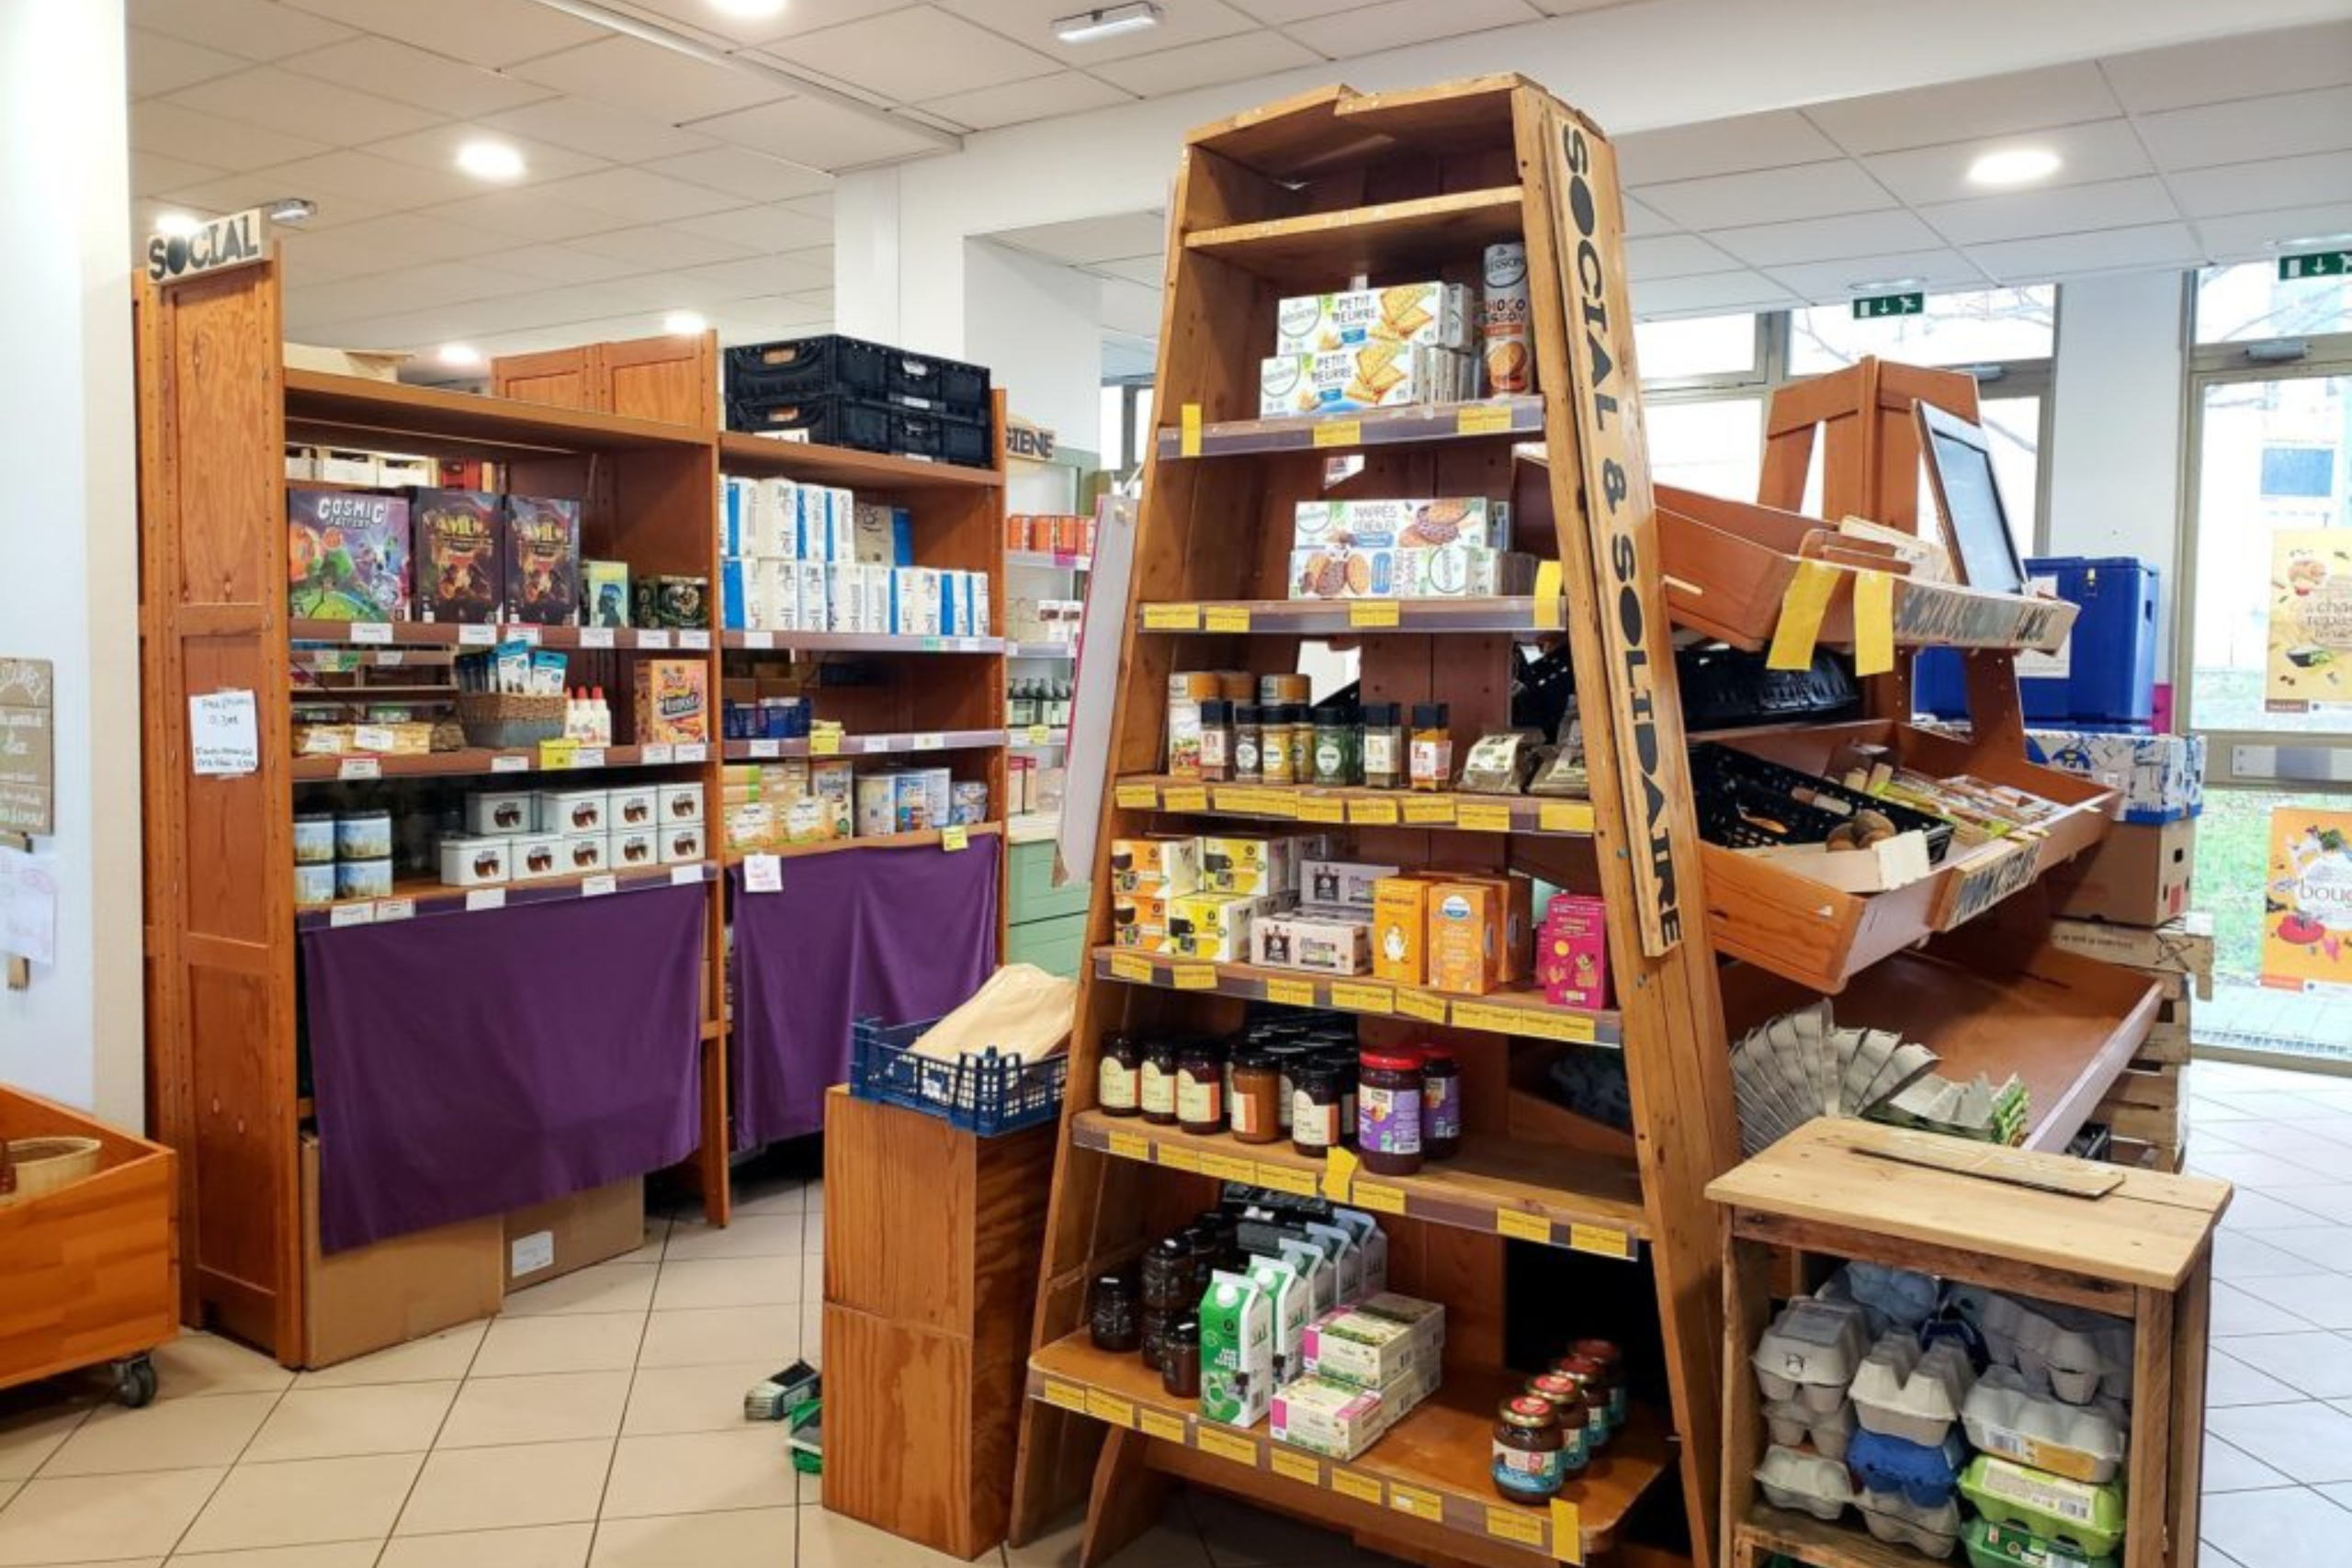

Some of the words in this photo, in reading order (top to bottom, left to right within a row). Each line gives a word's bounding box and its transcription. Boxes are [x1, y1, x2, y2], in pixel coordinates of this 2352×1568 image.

[149, 214, 258, 280] SOCIAL
[1565, 124, 1617, 432] SOCIAL
[1339, 294, 1371, 311] PETIT
[1332, 308, 1376, 324] BEURRE
[1316, 354, 1348, 368] PETIT
[1311, 367, 1352, 383] BEURRE
[1603, 457, 1626, 514] &
[318, 498, 385, 524] COSMIC
[1612, 533, 1680, 947] SOLIDAIRE
